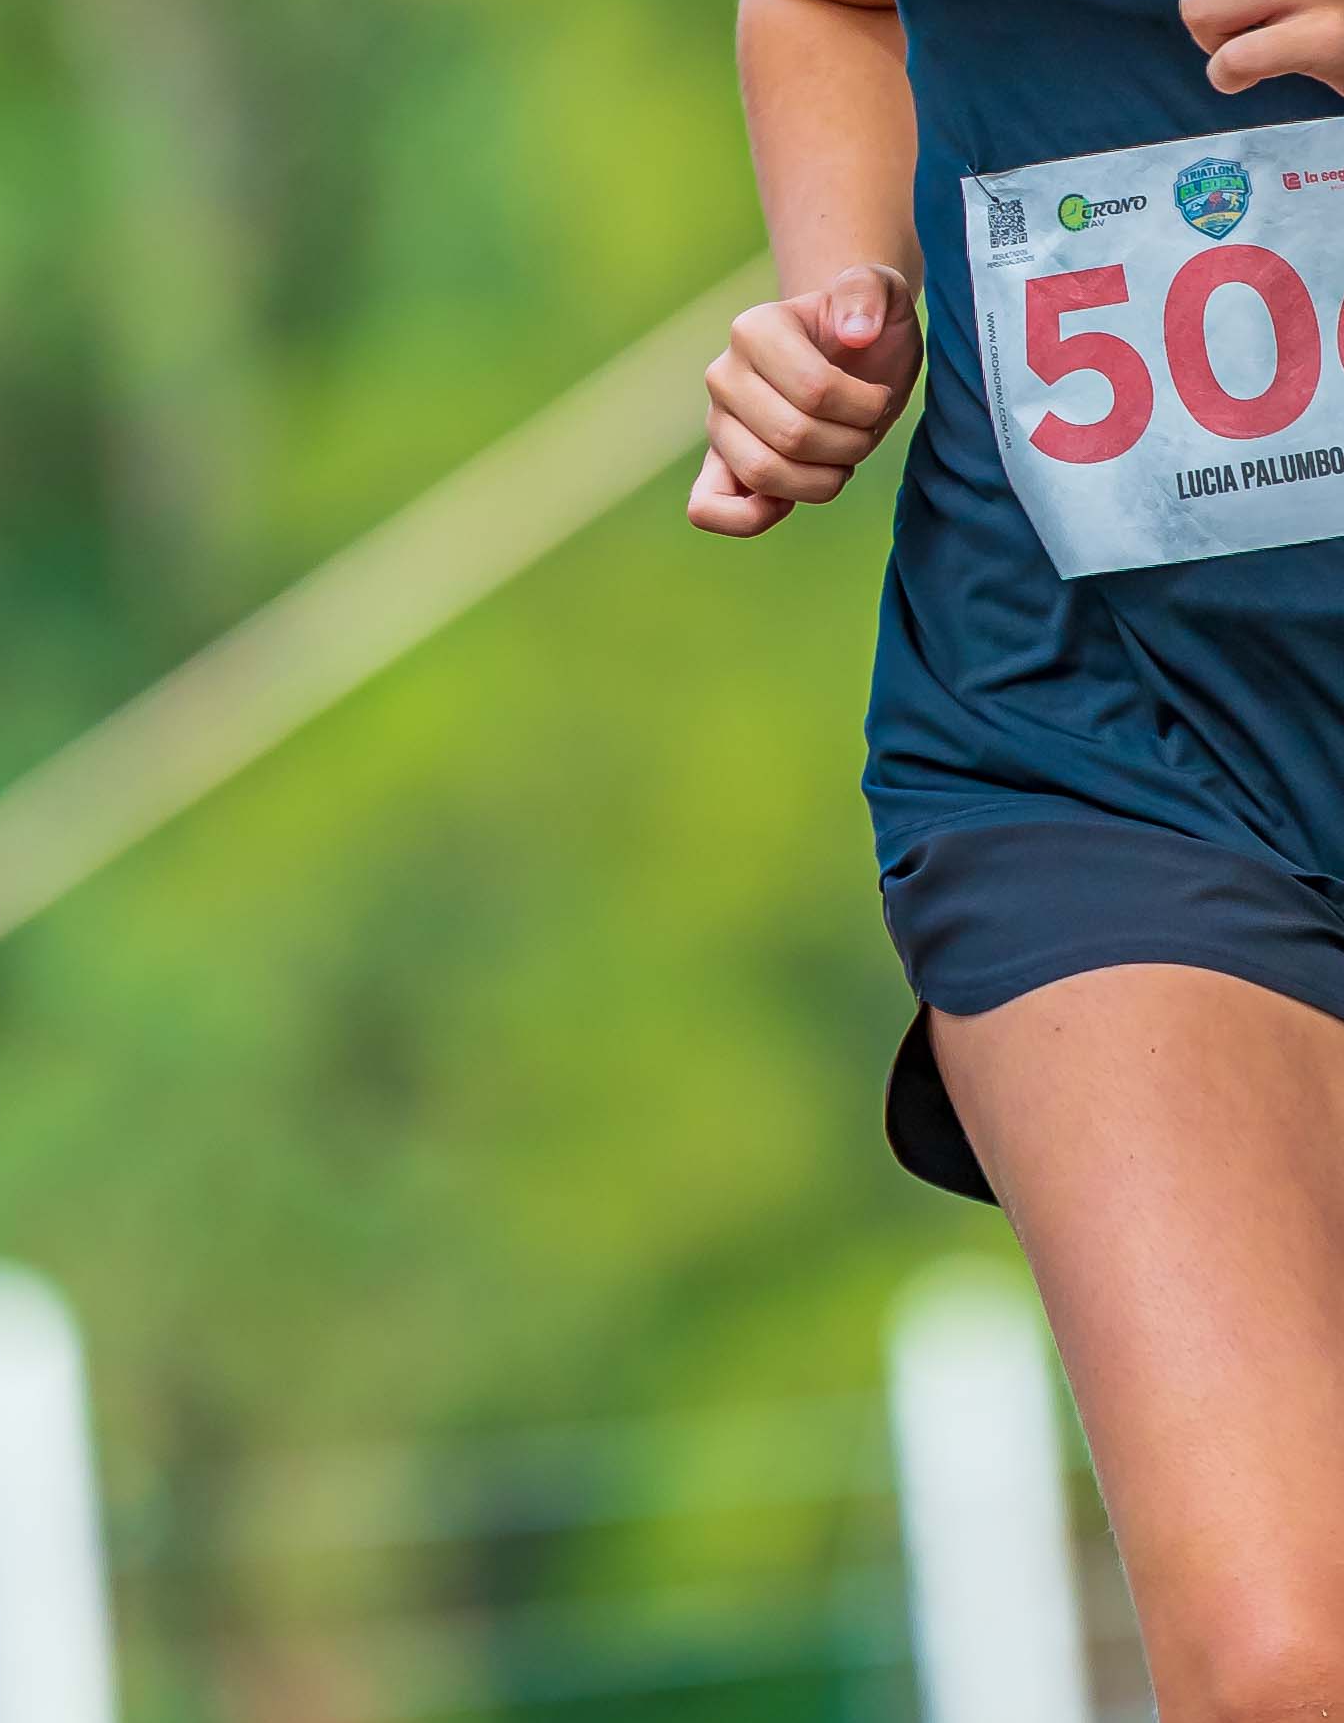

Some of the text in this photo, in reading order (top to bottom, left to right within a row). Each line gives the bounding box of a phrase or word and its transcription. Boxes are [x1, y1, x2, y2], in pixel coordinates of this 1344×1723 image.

[1304, 171, 1319, 184] la
[1082, 195, 1147, 219] CRONO
[1082, 219, 1105, 229] RAV
[1176, 464, 1239, 500] LUCIA
